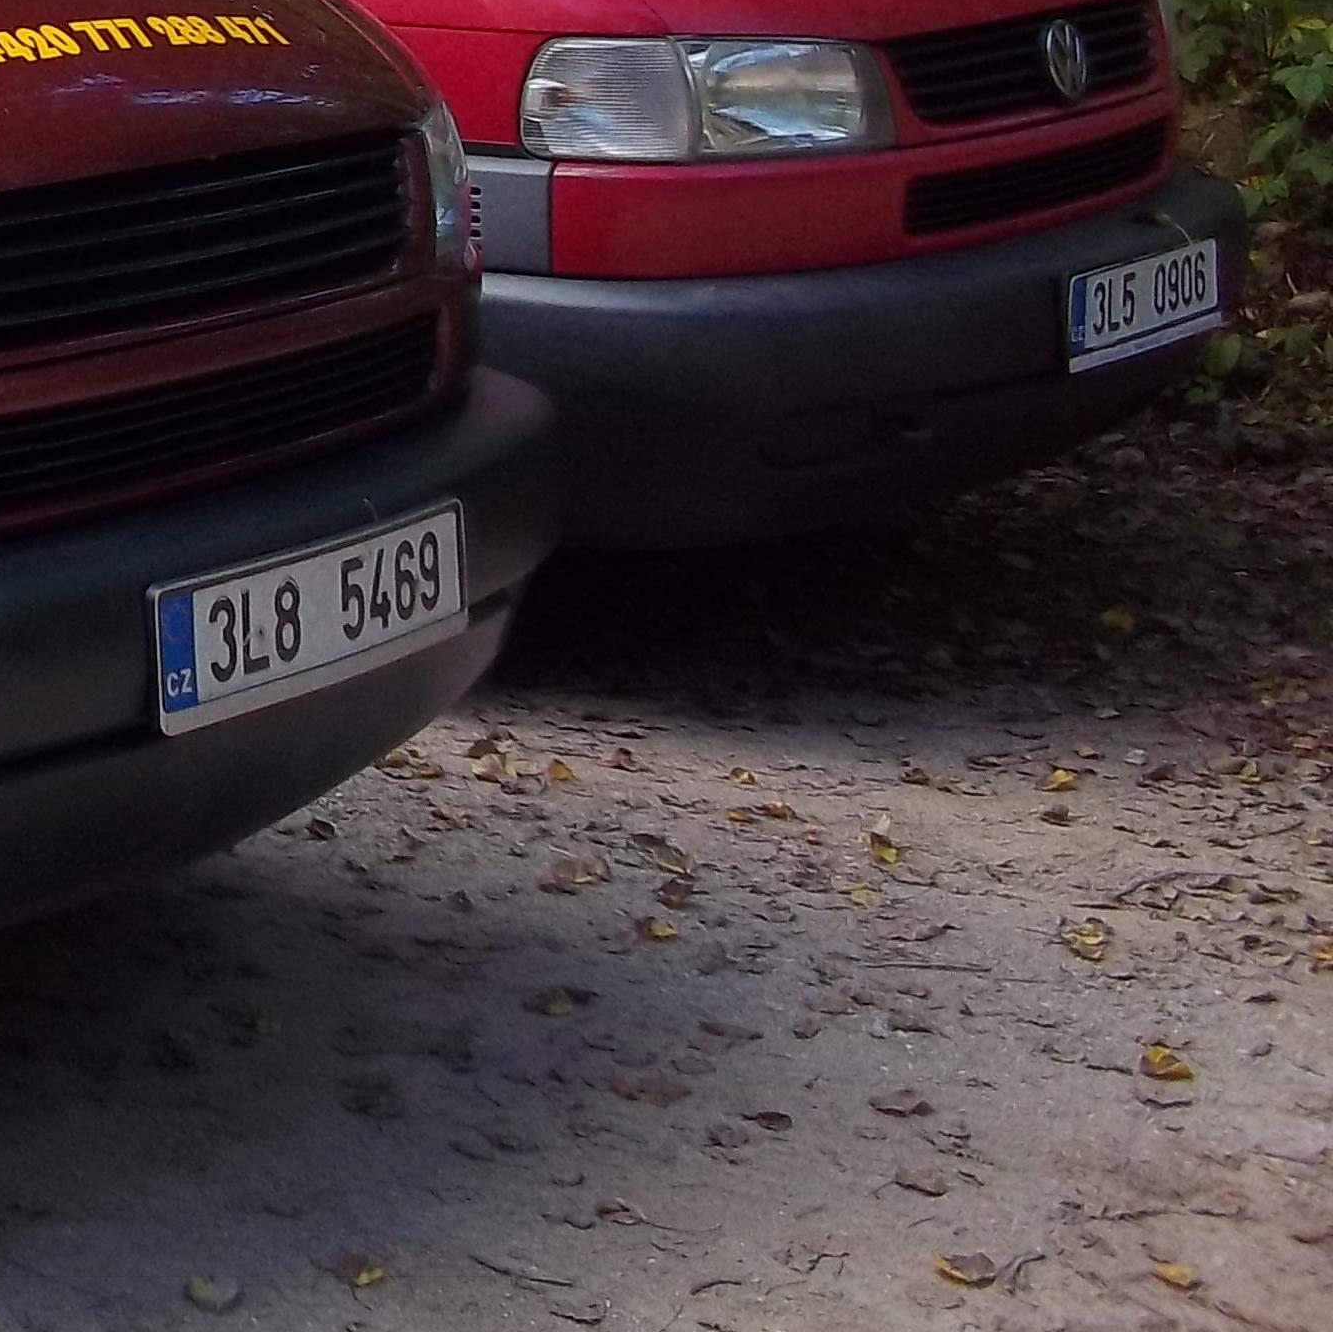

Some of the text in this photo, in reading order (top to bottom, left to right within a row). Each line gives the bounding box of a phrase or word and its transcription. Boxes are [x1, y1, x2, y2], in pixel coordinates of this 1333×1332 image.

[69, 17, 153, 51] 777
[215, 15, 291, 46] 471
[1093, 251, 1206, 335] 3L5 0906
[208, 530, 441, 683] 3L8 5469
[166, 668, 193, 697] CZ
